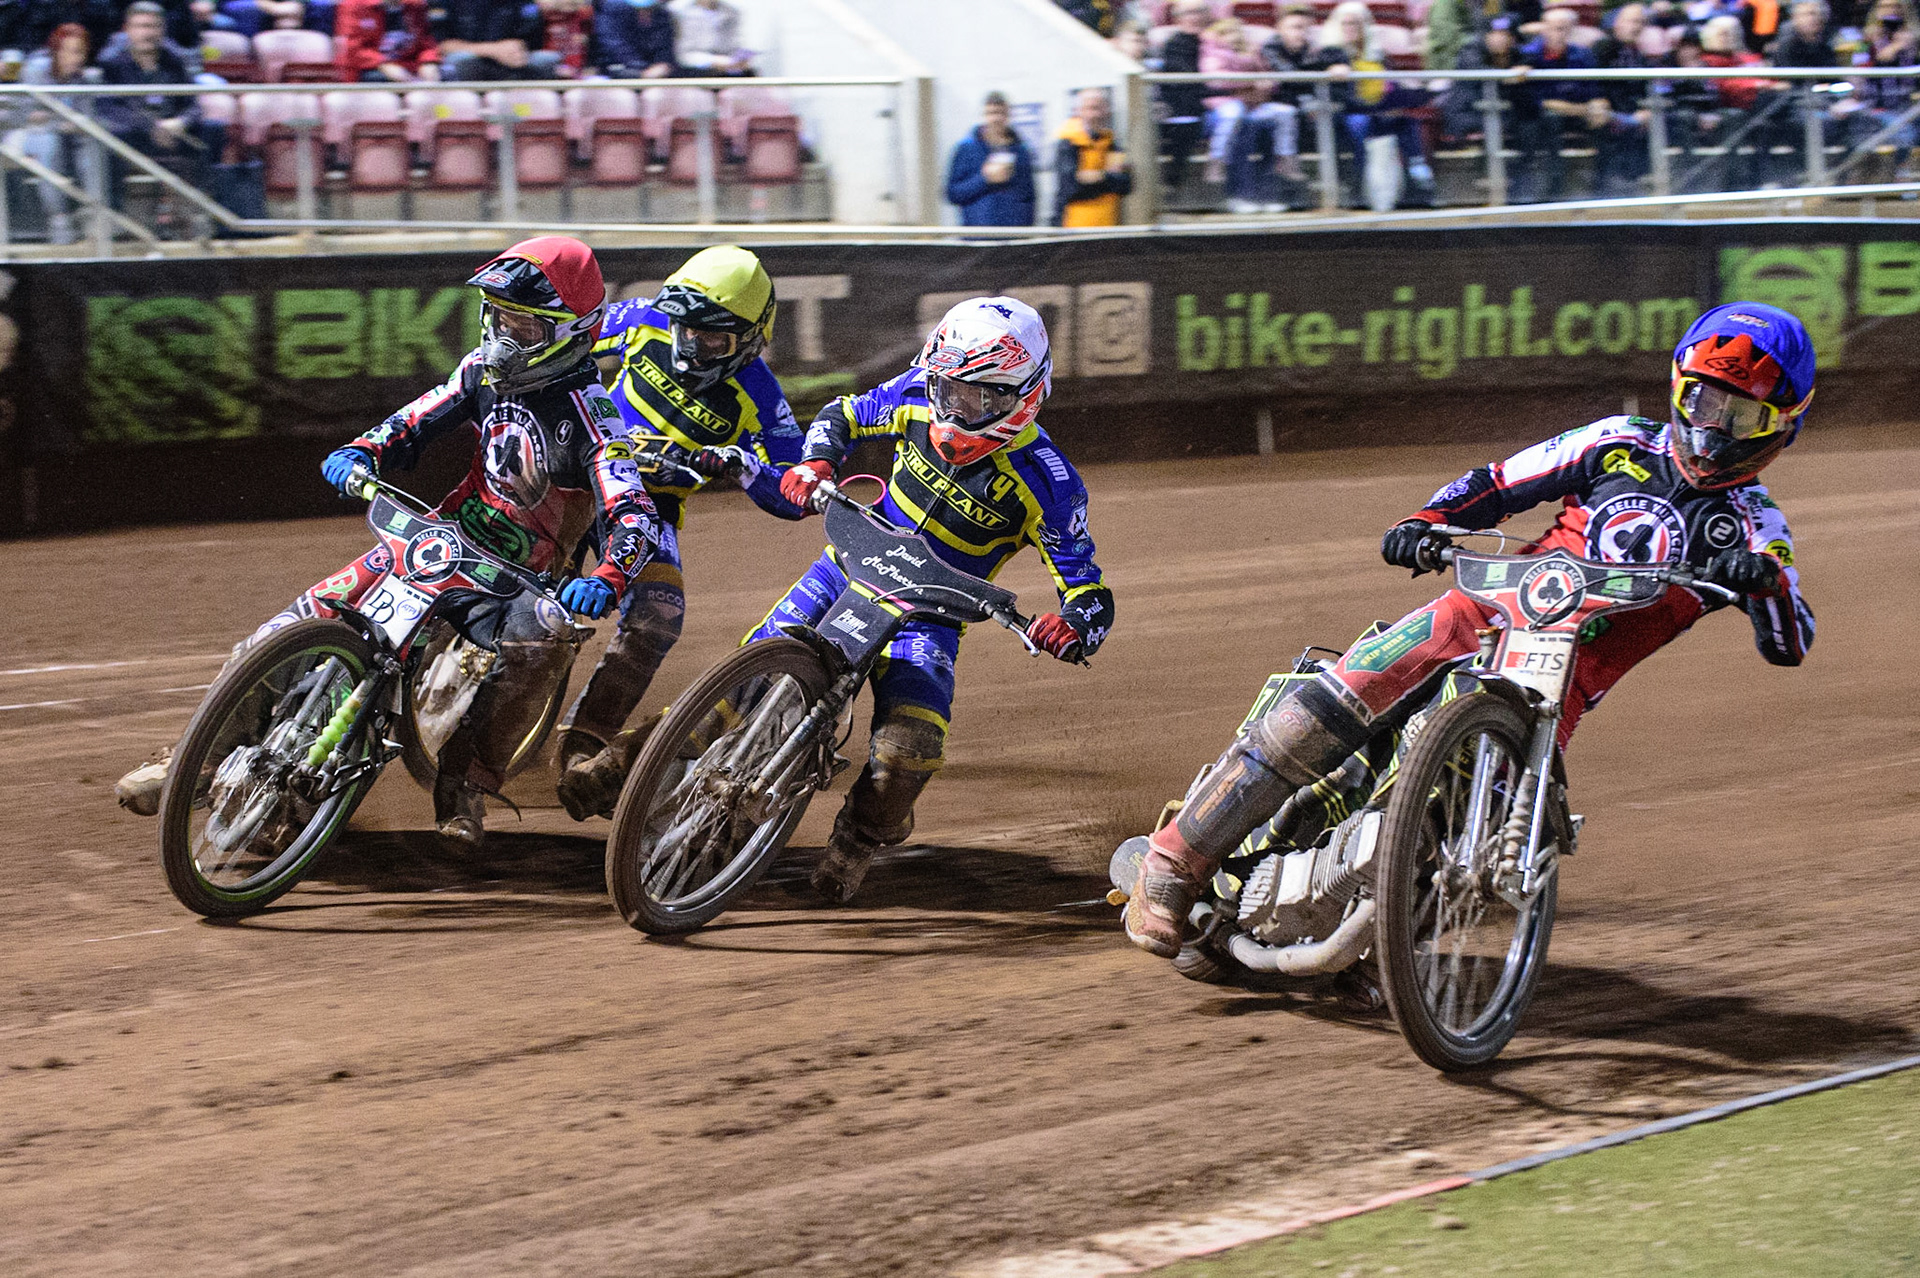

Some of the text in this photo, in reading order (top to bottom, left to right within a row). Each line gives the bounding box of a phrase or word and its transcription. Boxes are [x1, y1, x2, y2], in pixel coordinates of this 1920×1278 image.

[662, 302, 681, 313] BELL
[1176, 284, 1698, 379] bike-right.com
[641, 361, 727, 431] TRU PLANT
[906, 449, 1003, 527] TRU PLANT
[992, 474, 1015, 503] 4
[416, 531, 460, 559] BELLE VUE ACE
[1606, 499, 1682, 564] BELLE VUE ACES
[885, 545, 928, 569] David
[1524, 564, 1549, 585] BELLE
[1550, 562, 1569, 571] VUE
[1524, 652, 1566, 671] FTS
